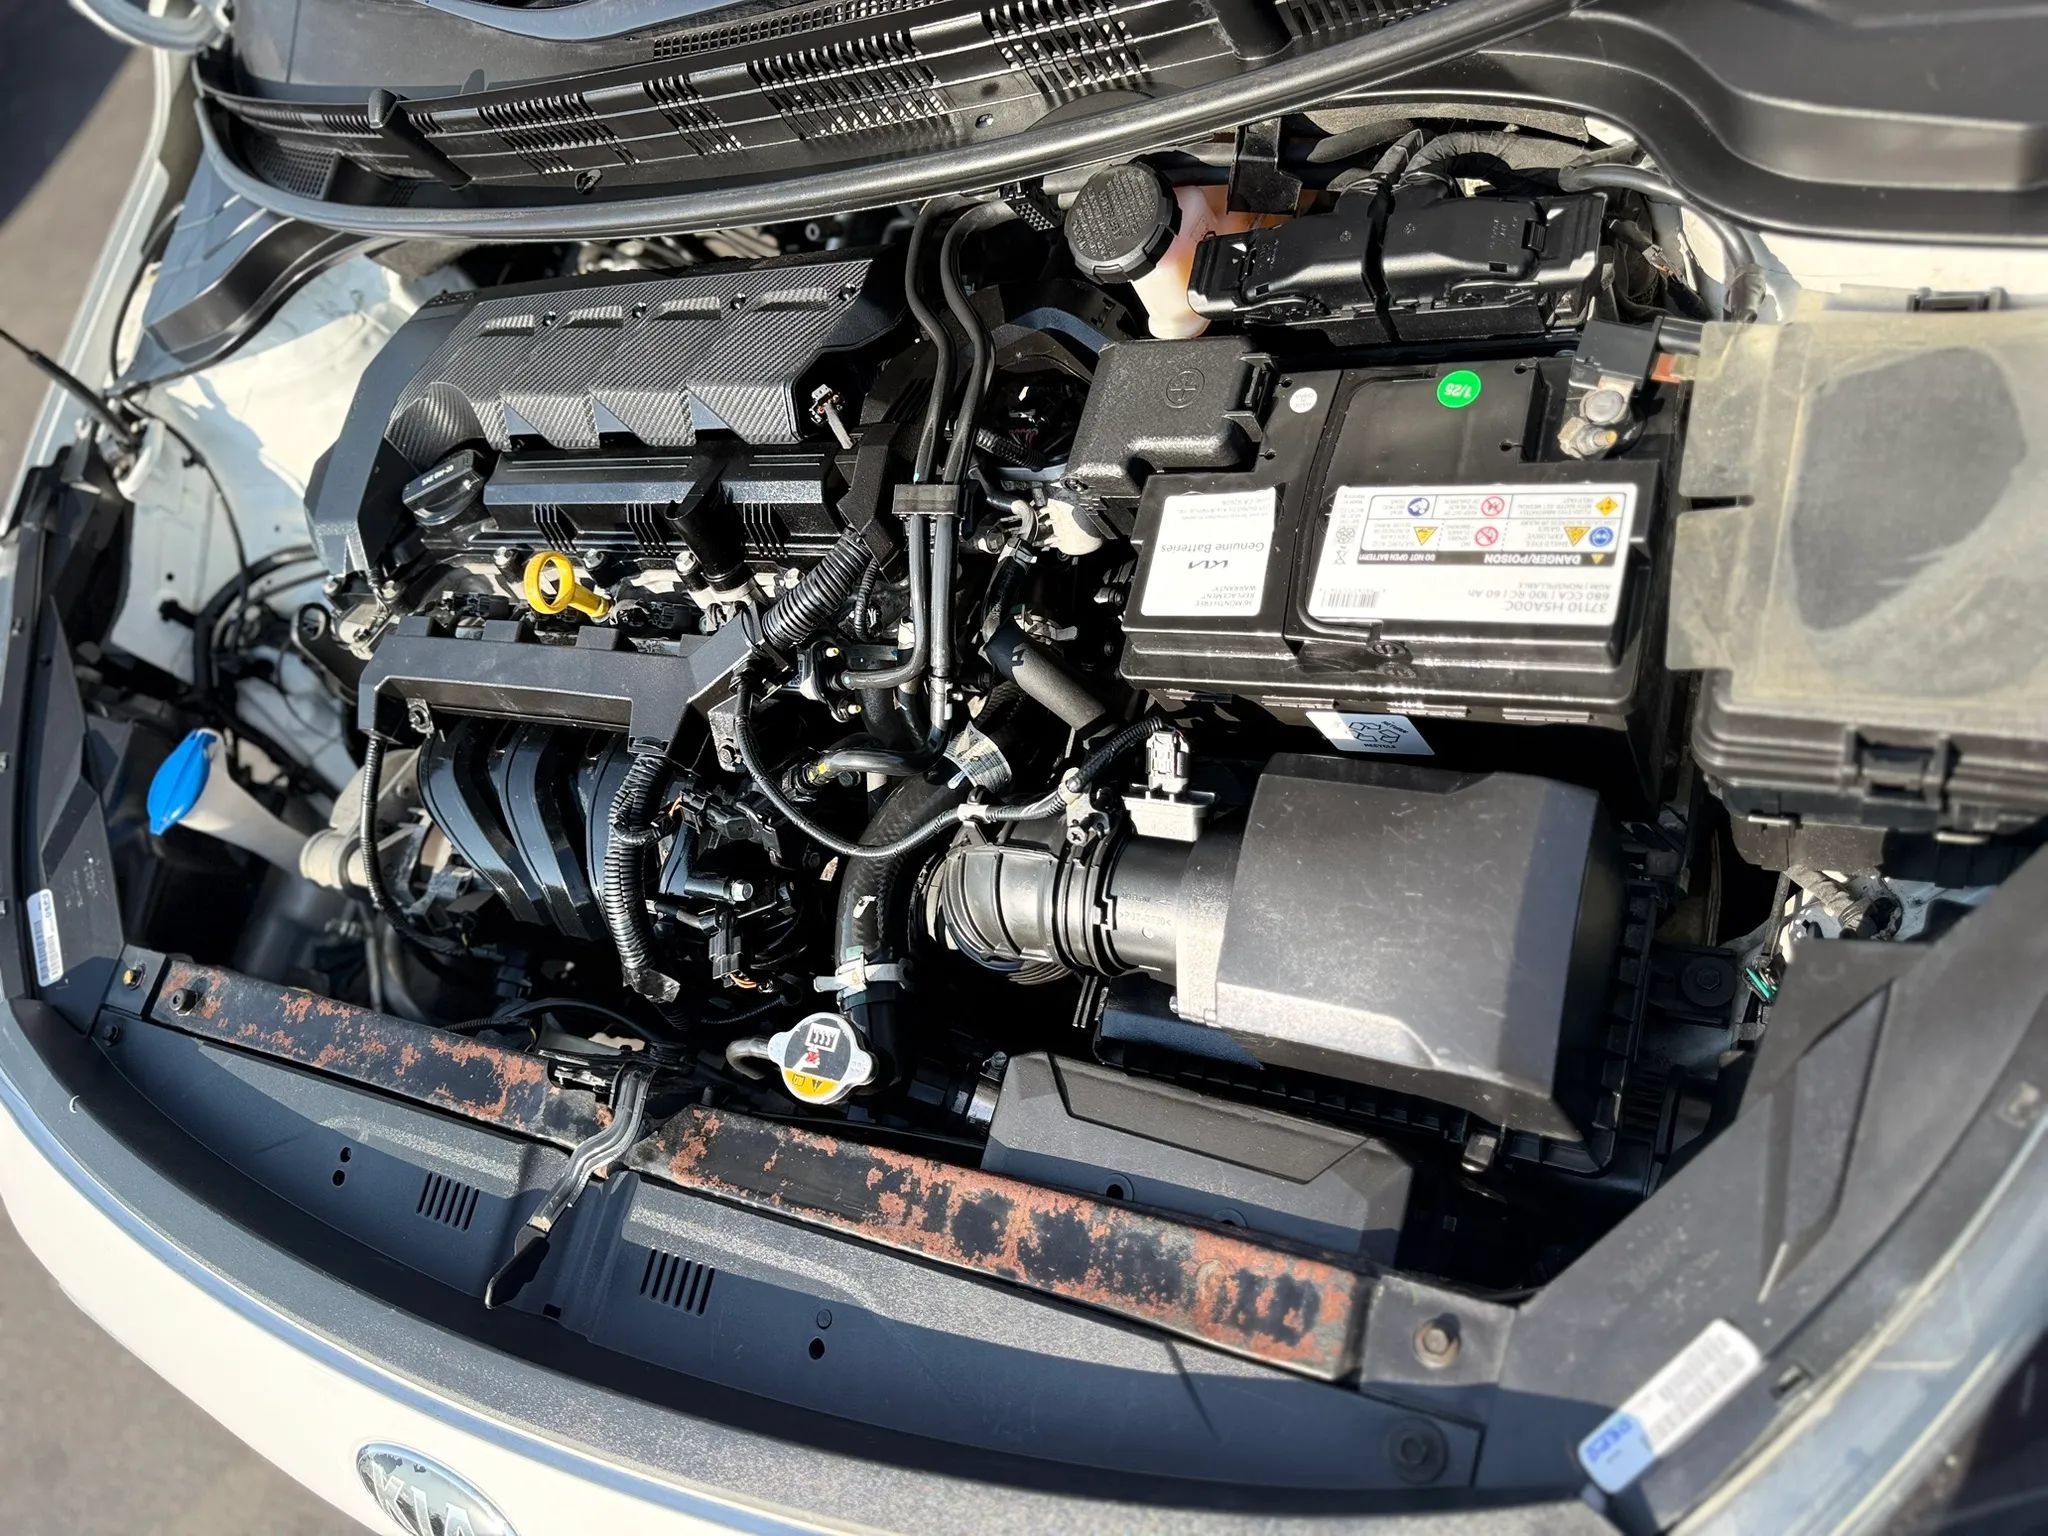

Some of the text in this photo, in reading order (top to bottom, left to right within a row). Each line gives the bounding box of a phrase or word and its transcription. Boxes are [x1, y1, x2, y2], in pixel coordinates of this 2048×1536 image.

[1443, 382, 1472, 399] 1/25
[1160, 542, 1265, 554] Genuine Batteries
[1390, 553, 1409, 561] OPEN
[1409, 553, 1424, 561] NOT
[1425, 553, 1436, 562] DO
[1484, 553, 1582, 565] DANGER/POISON
[1187, 560, 1229, 570] KIA
[1468, 588, 1484, 599] Ah
[1486, 589, 1501, 599] 60
[1558, 591, 1584, 601] CCA
[1586, 591, 1611, 601] 680
[1567, 601, 1608, 614] 37110
